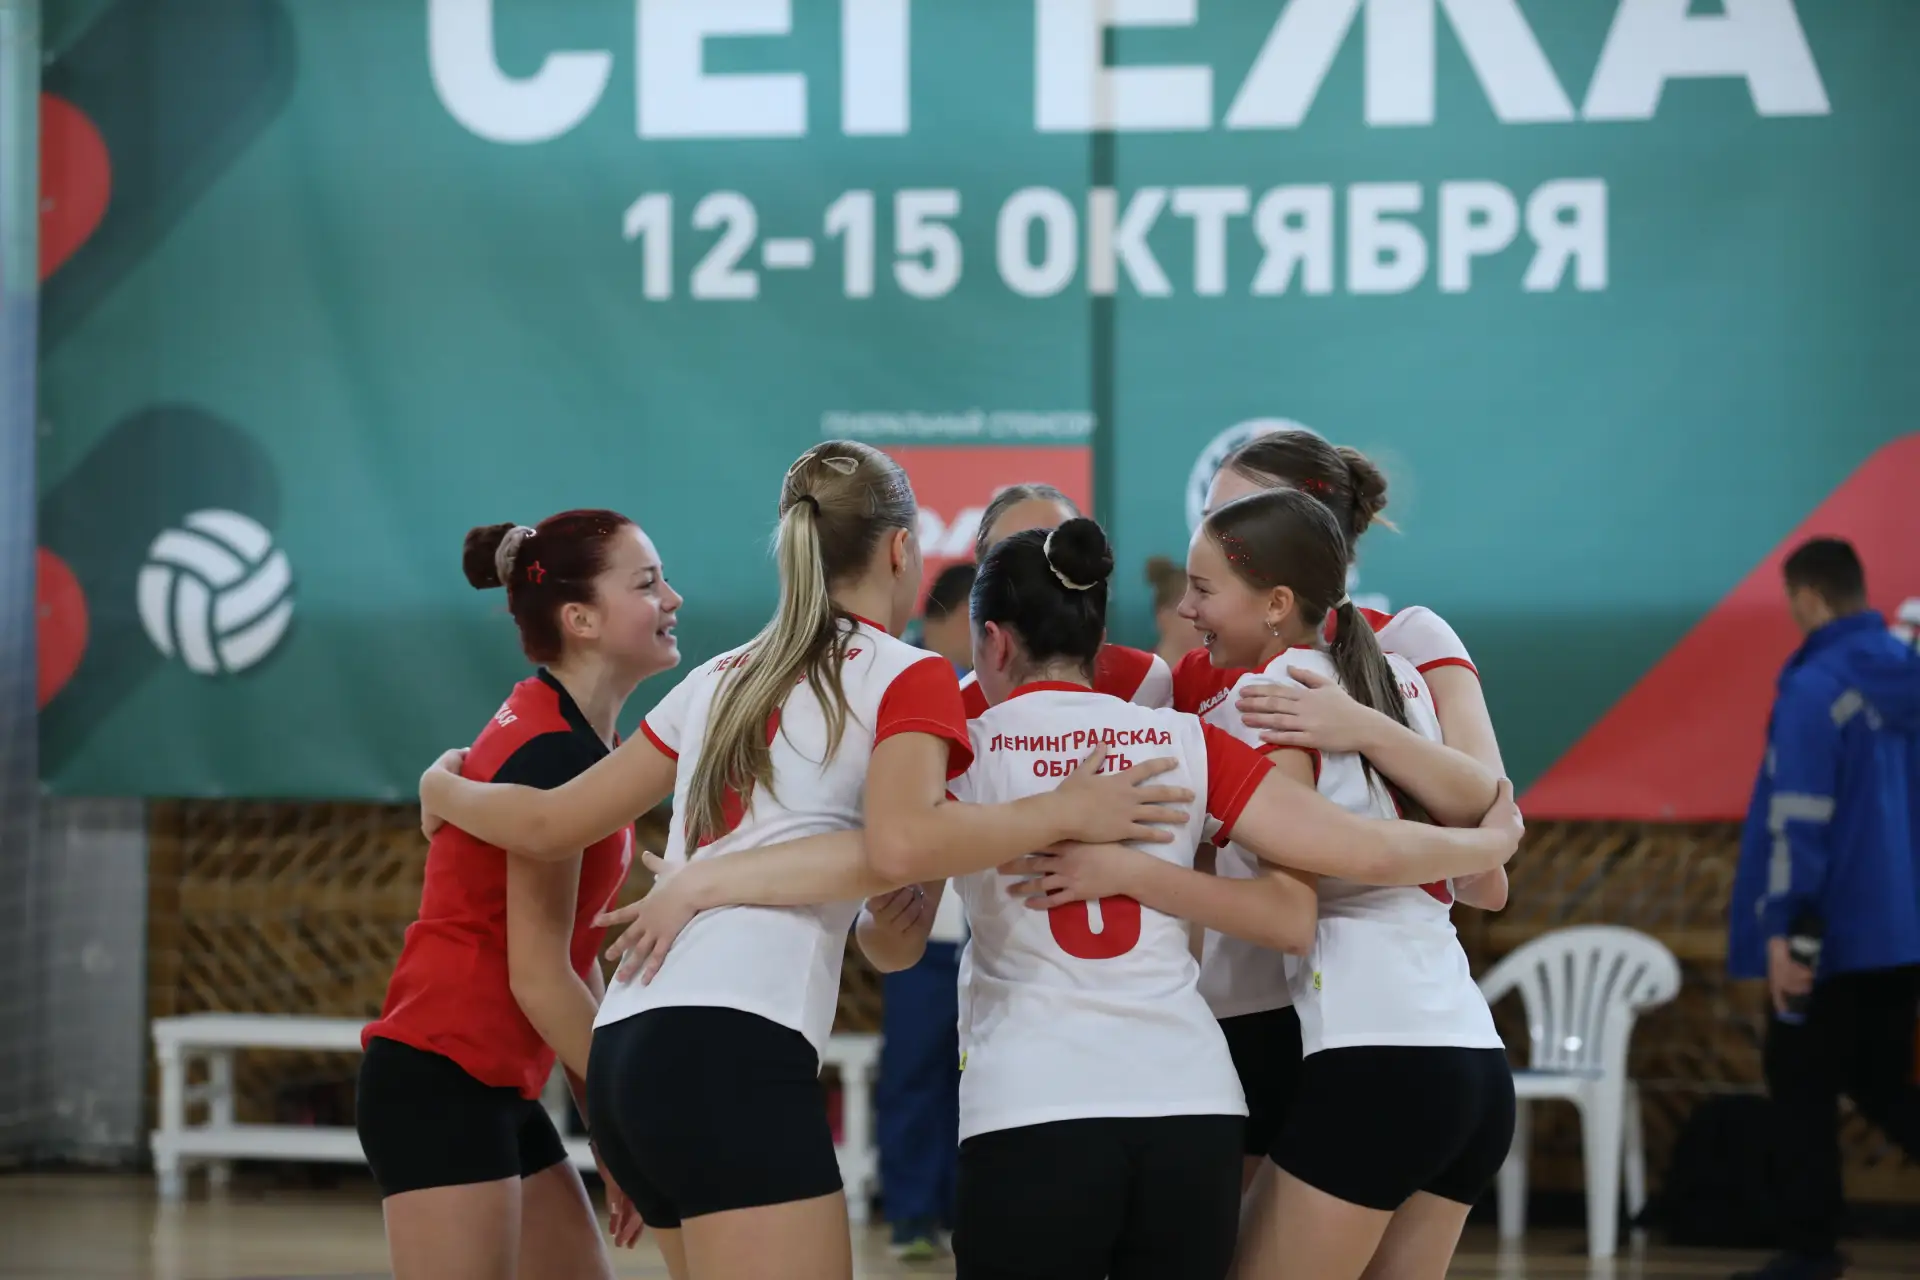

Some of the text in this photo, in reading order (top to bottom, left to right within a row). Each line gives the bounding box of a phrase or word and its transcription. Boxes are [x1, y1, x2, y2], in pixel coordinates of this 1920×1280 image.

[623, 178, 1608, 300] 12-15 ОКТЯБРЯ
[989, 727, 1172, 752] ЛЕНИНГРАДСКАЯ
[1032, 753, 1133, 778] ОБЛТЬ
